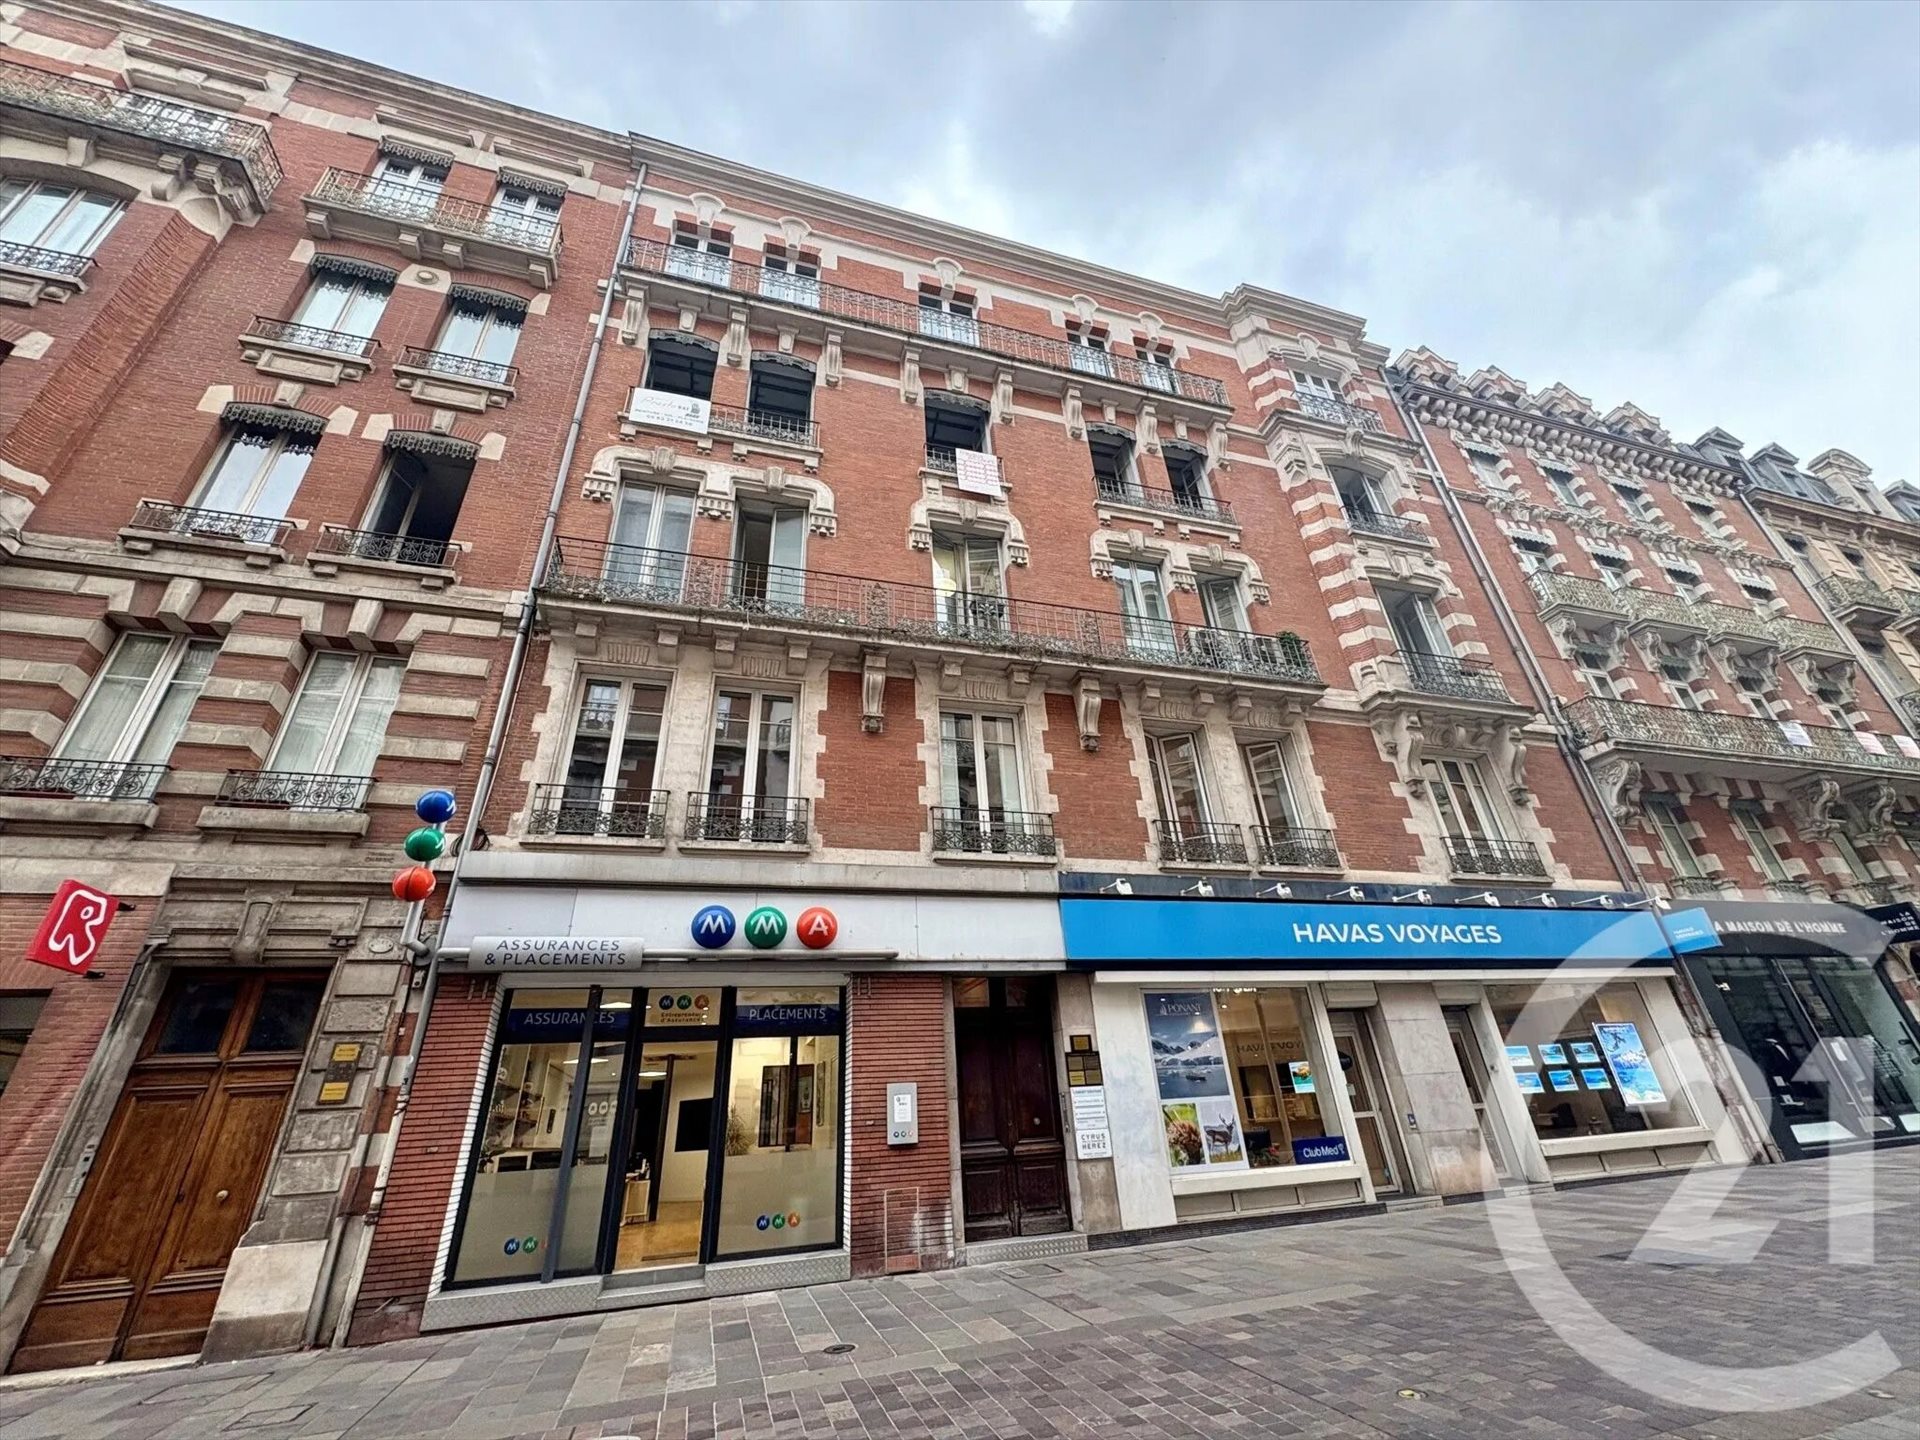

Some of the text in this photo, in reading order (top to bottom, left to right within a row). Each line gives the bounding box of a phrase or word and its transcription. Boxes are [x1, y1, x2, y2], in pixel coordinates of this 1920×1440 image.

[1292, 922, 1502, 945] HAVAS VOYAGES
[1725, 920, 1776, 934] MAISON
[1793, 921, 1848, 934] L'HOMME
[496, 939, 620, 951] ASSURANCES
[484, 952, 626, 966] & PLACEMENTS
[524, 1011, 616, 1025] ASSURANES
[749, 1007, 826, 1021] PLACEMENTS
[1080, 1132, 1106, 1141] CYRUS
[1081, 1142, 1107, 1150] HEREZ
